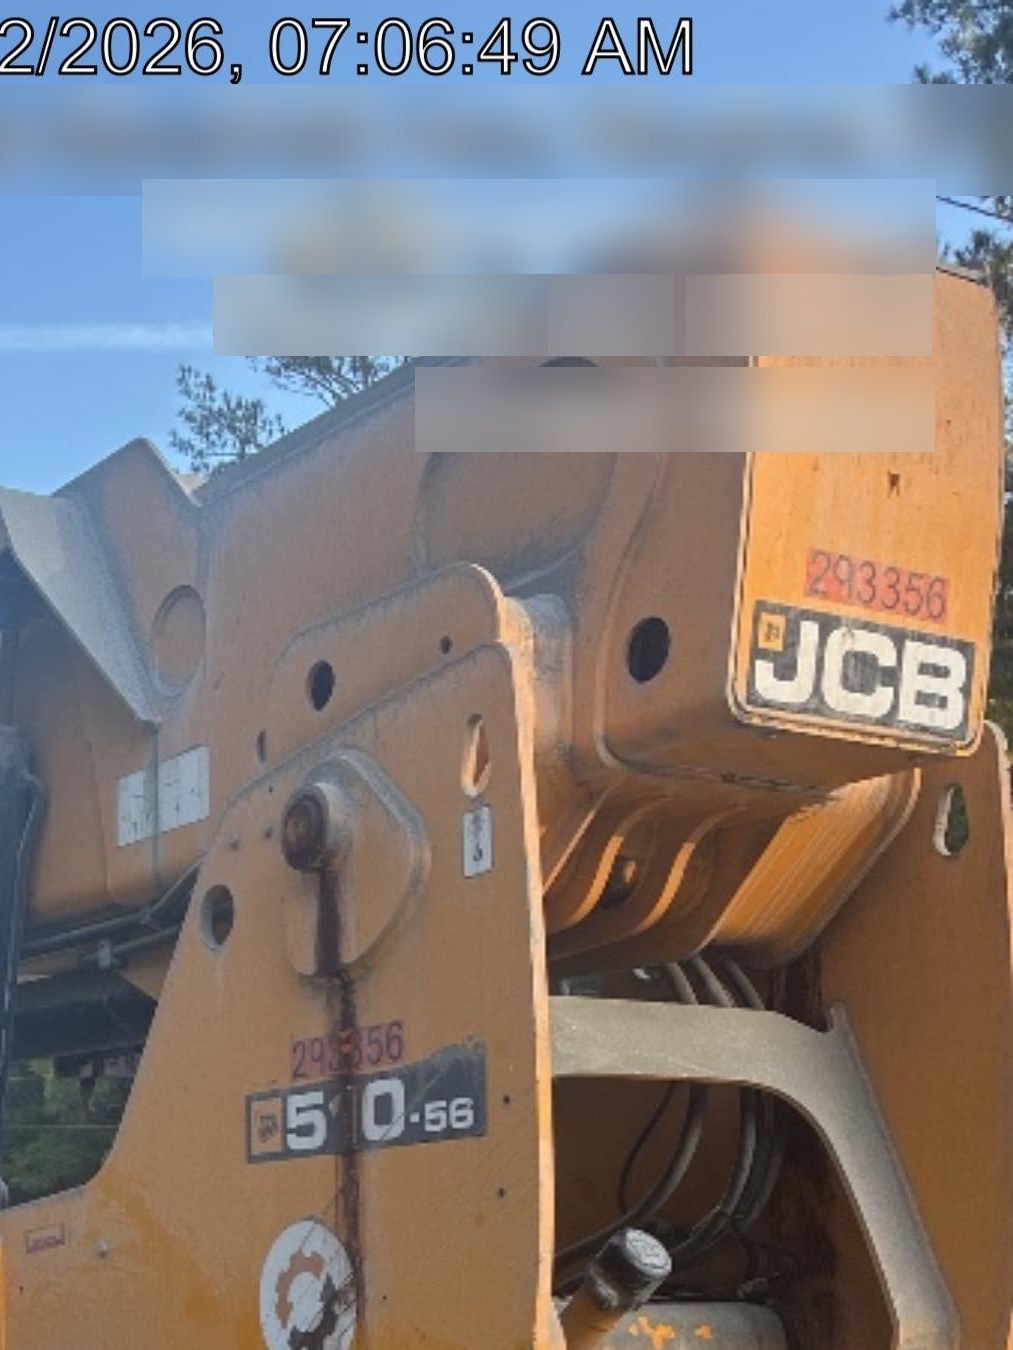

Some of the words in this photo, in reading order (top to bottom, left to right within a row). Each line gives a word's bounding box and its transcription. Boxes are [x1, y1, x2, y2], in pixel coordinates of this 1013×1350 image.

[808, 550, 949, 621] 293356
[754, 619, 967, 730] JCB
[286, 1078, 475, 1150] 50-56
